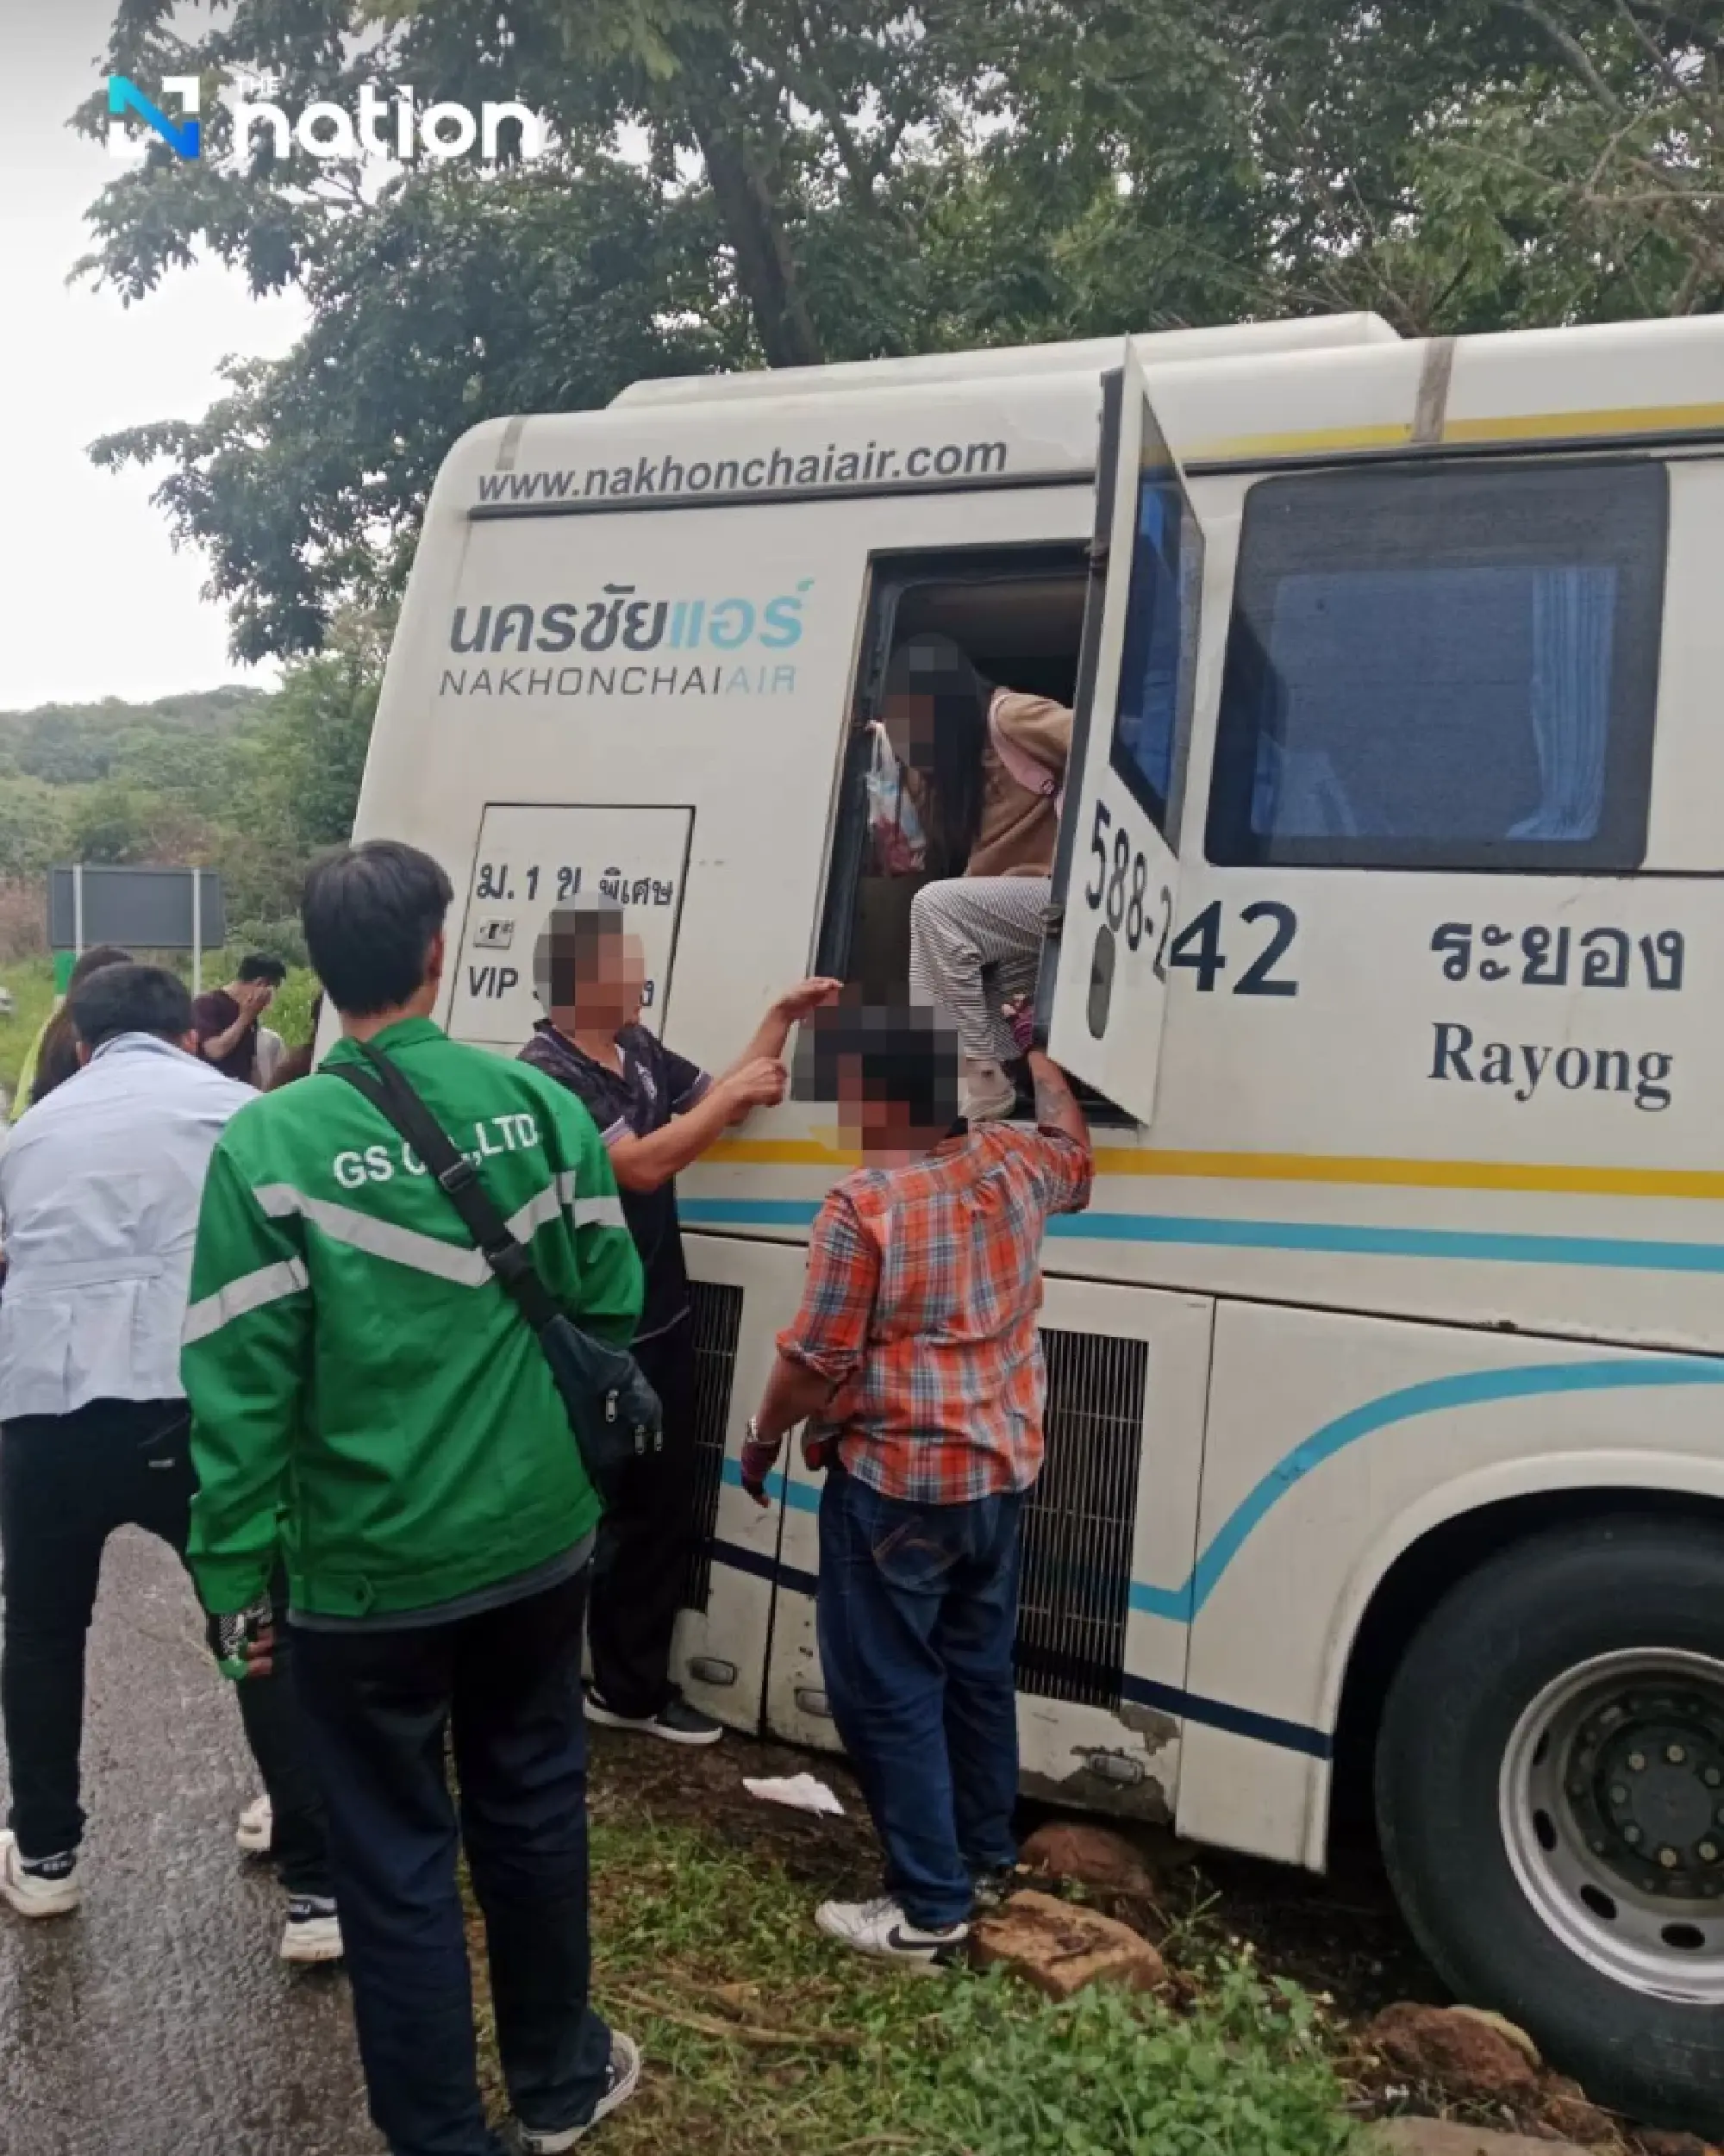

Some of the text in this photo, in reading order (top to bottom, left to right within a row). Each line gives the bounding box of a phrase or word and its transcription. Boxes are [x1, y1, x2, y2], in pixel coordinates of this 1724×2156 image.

[478, 440, 1008, 502] www.nakhonchaiair.com
[449, 577, 815, 653] นครชัยแอร์
[469, 966, 518, 998] VIP
[1430, 922, 1684, 991] ระยอง
[1427, 1022, 1674, 1112] Rayong
[334, 1146, 394, 1189] GS
